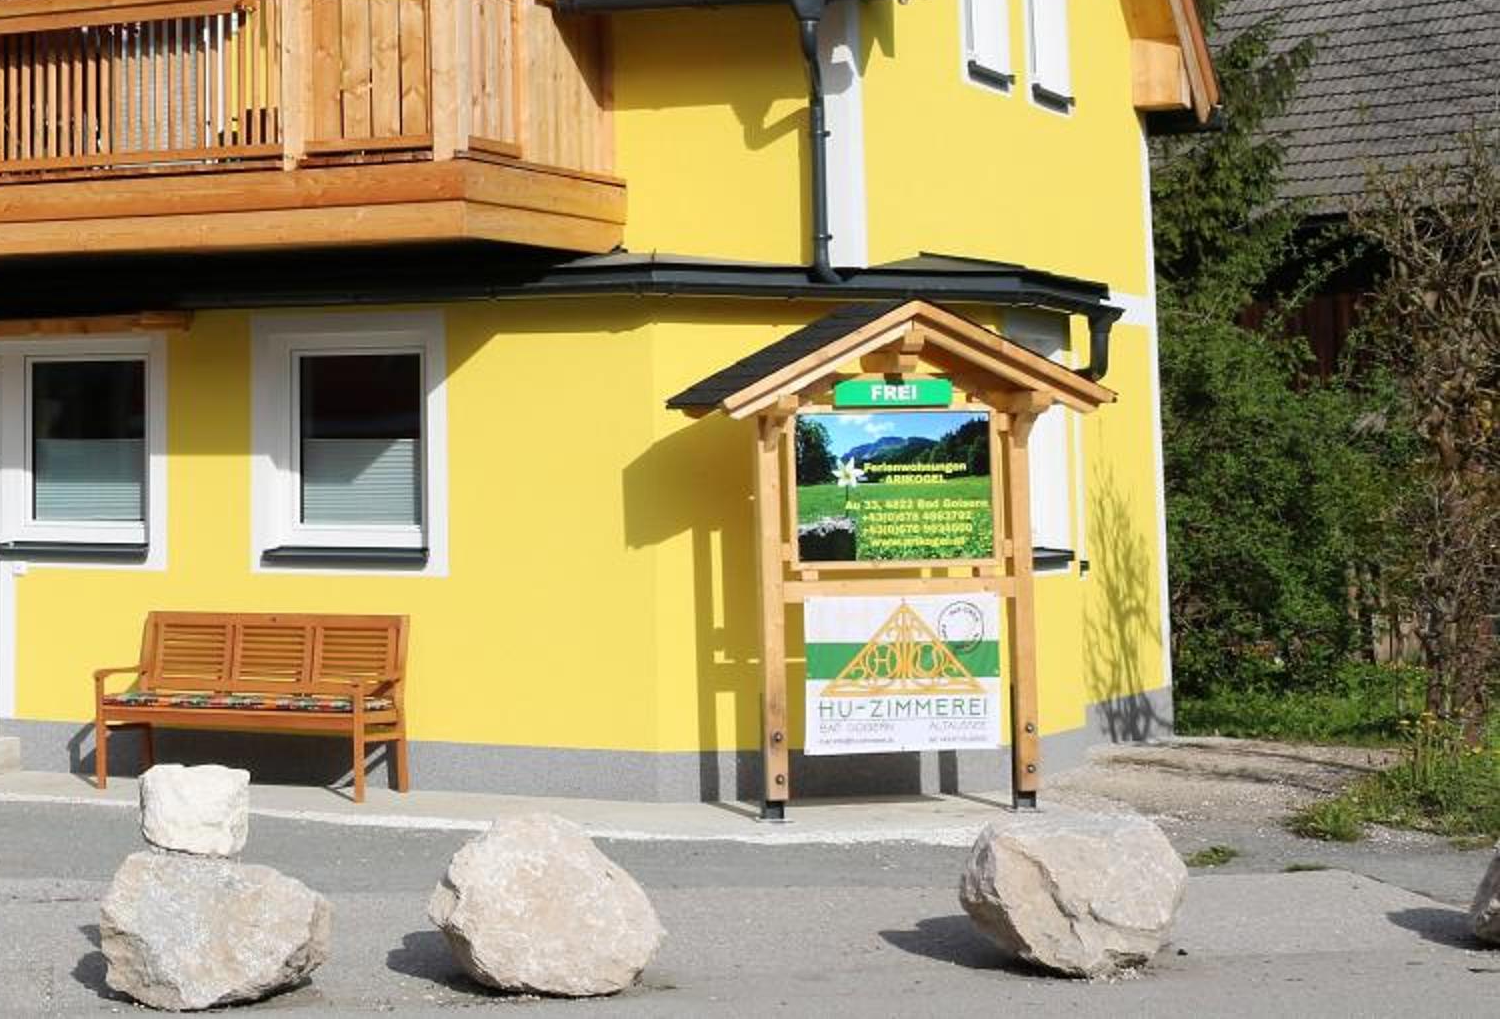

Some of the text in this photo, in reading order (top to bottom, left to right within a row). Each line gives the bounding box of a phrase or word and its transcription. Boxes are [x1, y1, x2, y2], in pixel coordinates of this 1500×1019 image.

[871, 384, 917, 400] FREI
[863, 462, 967, 474] Ferienwohnungen
[917, 499, 939, 509] Bad
[943, 498, 989, 508] Goisern
[818, 698, 988, 718] HU-ZIMMEREI
